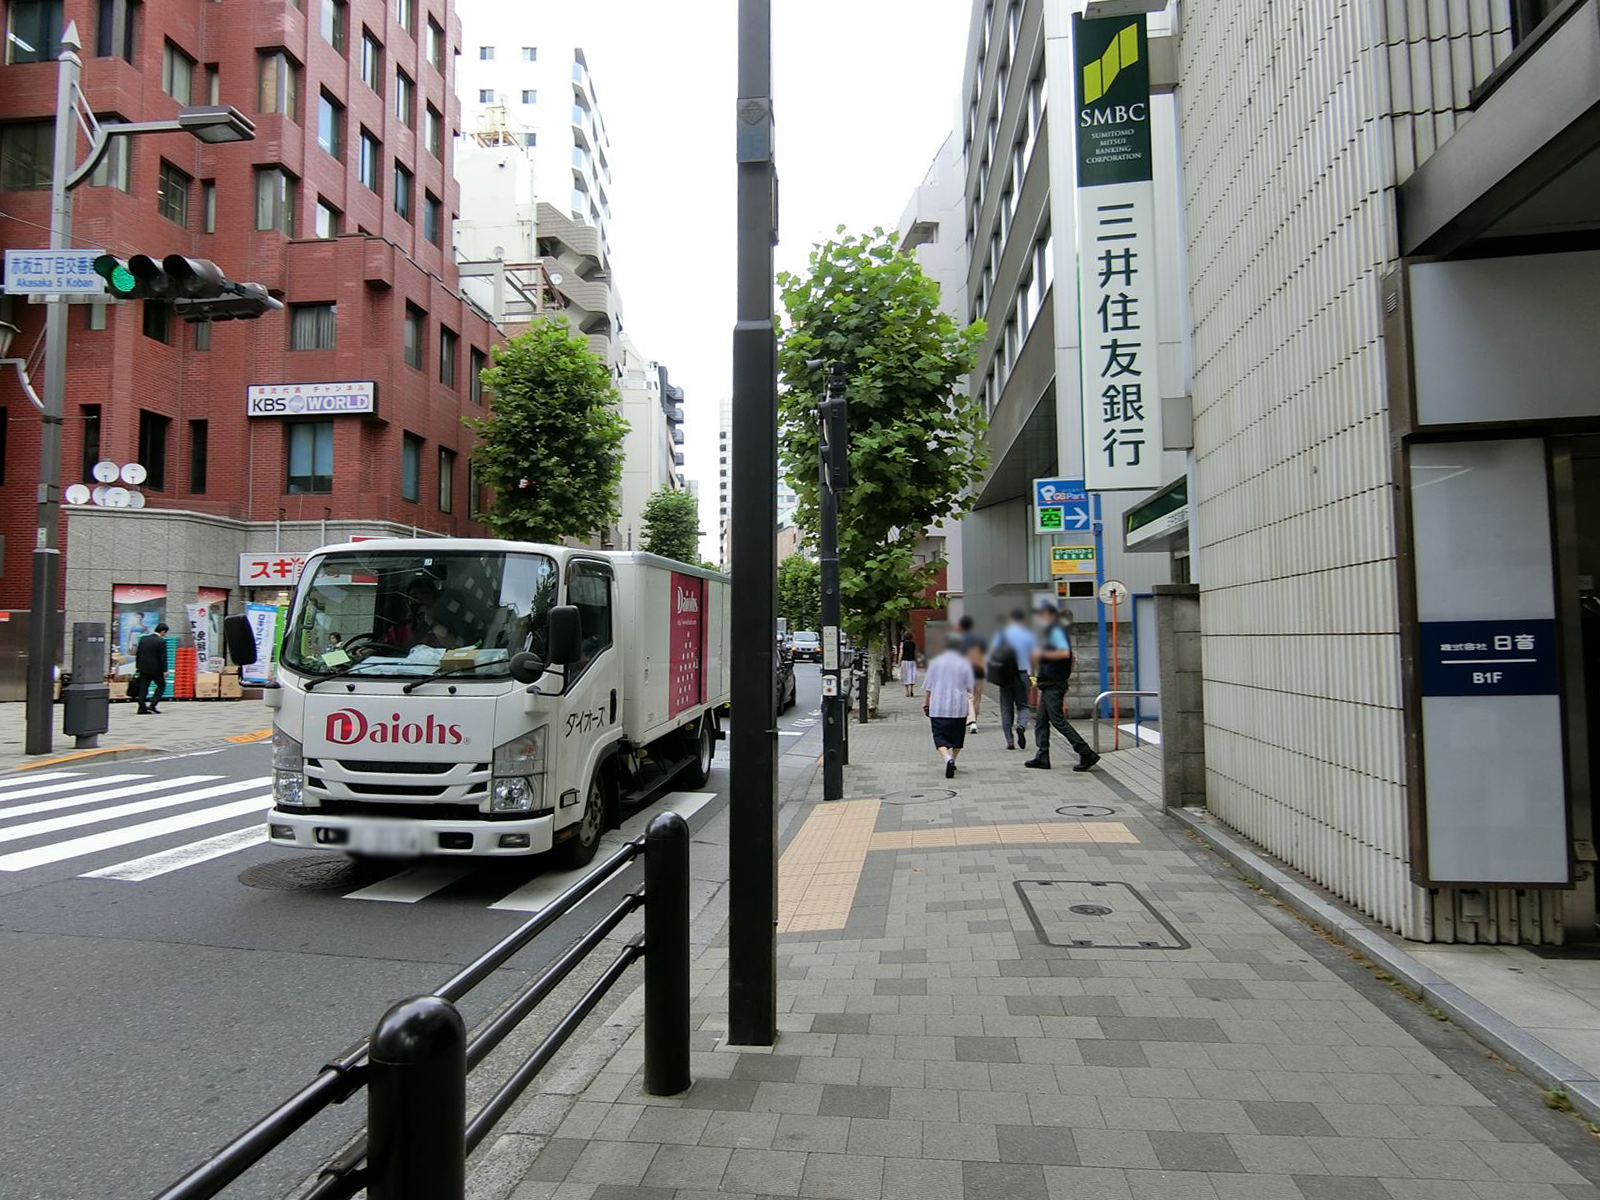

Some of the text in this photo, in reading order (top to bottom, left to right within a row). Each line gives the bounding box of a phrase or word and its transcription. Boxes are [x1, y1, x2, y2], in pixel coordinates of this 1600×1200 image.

[1080, 103, 1146, 127] SMBC
[1091, 128, 1135, 139] SUMITOMO
[1095, 145, 1132, 155] BANKING
[1099, 138, 1126, 146] MITSUI
[1085, 152, 1142, 164] CORPORATION
[17, 278, 95, 288] Akasaka 5 Koban
[1096, 203, 1145, 467] 三井住友銀行
[252, 395, 368, 413] KBS WORLD
[677, 586, 698, 614] Daiohs
[1494, 634, 1535, 650] 日音
[1472, 672, 1502, 684] B1F
[326, 708, 463, 745] Daiohs
[566, 706, 605, 738] ダイオーズ
